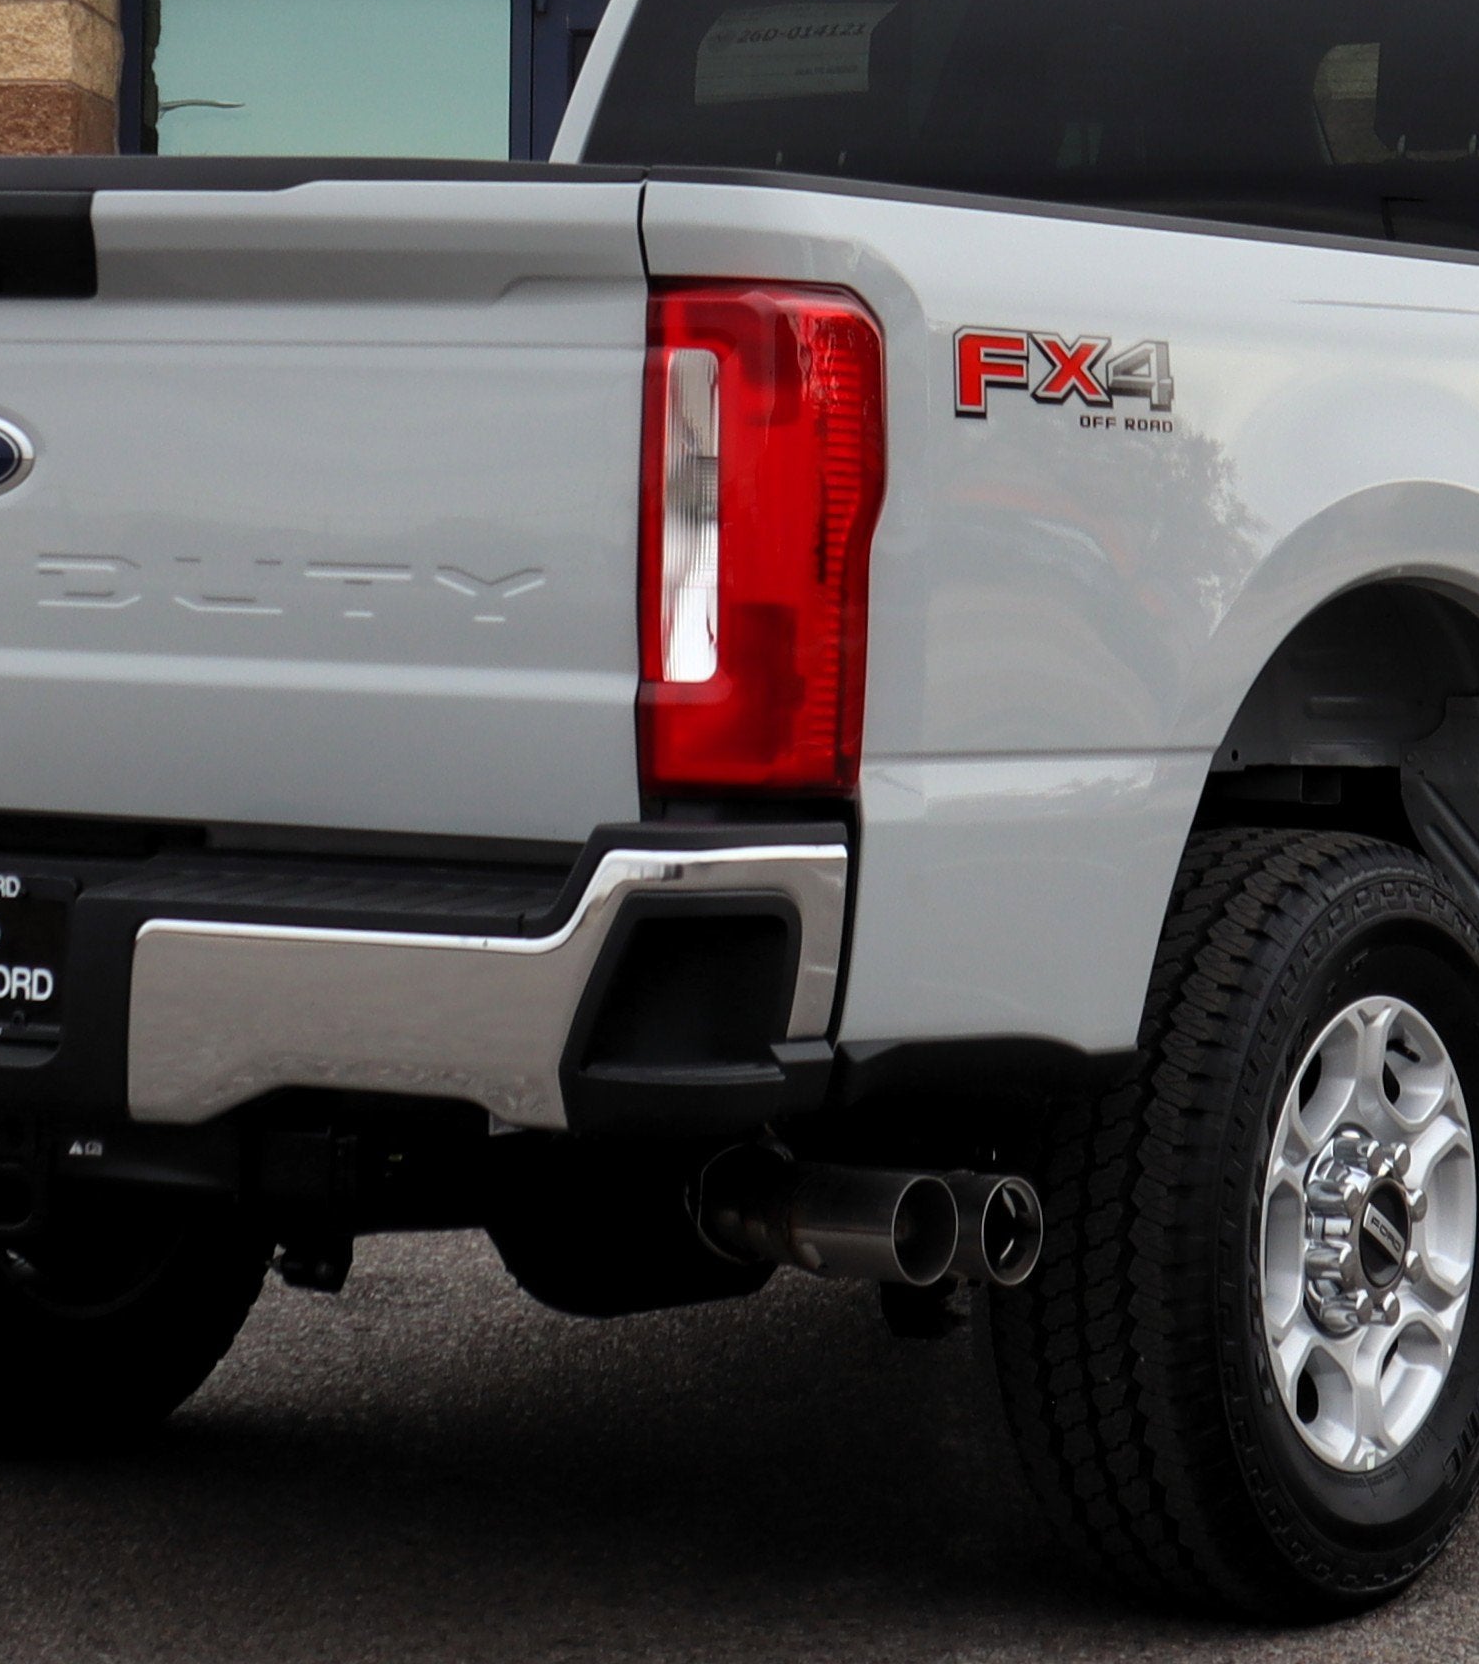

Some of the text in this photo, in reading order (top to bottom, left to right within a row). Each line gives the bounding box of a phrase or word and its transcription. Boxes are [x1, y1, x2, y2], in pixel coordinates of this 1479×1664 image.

[953, 325, 1175, 419] FX4
[1079, 414, 1174, 434] OFF ROAD
[35, 551, 547, 624] DUTY
[1370, 1215, 1402, 1253] FORD
